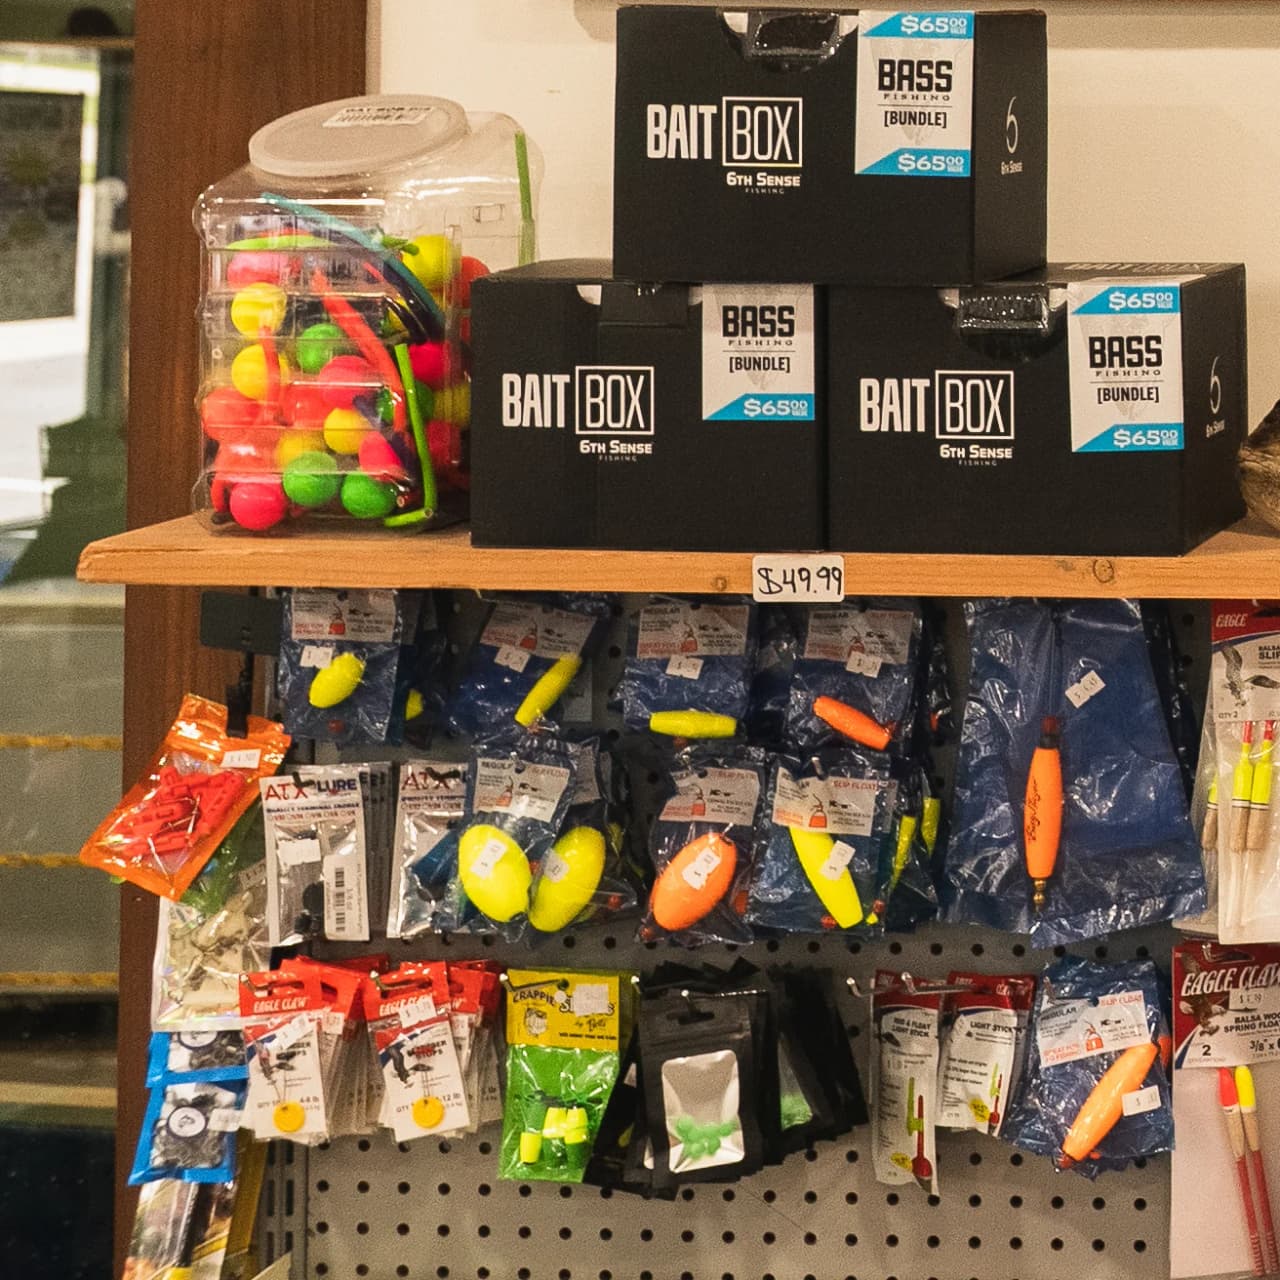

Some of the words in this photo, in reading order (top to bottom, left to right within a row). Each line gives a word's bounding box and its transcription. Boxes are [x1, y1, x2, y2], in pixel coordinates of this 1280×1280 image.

[878, 59, 952, 92] BASS
[884, 93, 950, 101] FISHING
[885, 111, 947, 128] [BUNDLE]
[647, 104, 717, 159] BAIT
[732, 106, 793, 160] BOX
[722, 306, 795, 337] BASS
[1089, 336, 1162, 368] BASS
[729, 357, 790, 372] [BUNDLE]
[502, 373, 570, 428] BAIT
[586, 375, 644, 429] BOX
[1097, 387, 1159, 404] [BUNDLE]
[860, 378, 930, 432] BAIT
[946, 379, 1005, 432] BOX
[757, 567, 843, 595] $49.99
[1216, 614, 1248, 628] EAGLE
[317, 779, 357, 793] LURE
[1181, 972, 1234, 997] EAGLE
[254, 1000, 280, 1013] EAGLE
[282, 998, 306, 1010] CLAW
[1223, 1023, 1255, 1033] SPRING
[1234, 1015, 1262, 1025] BALSA
[1202, 1044, 1211, 1057] 2
